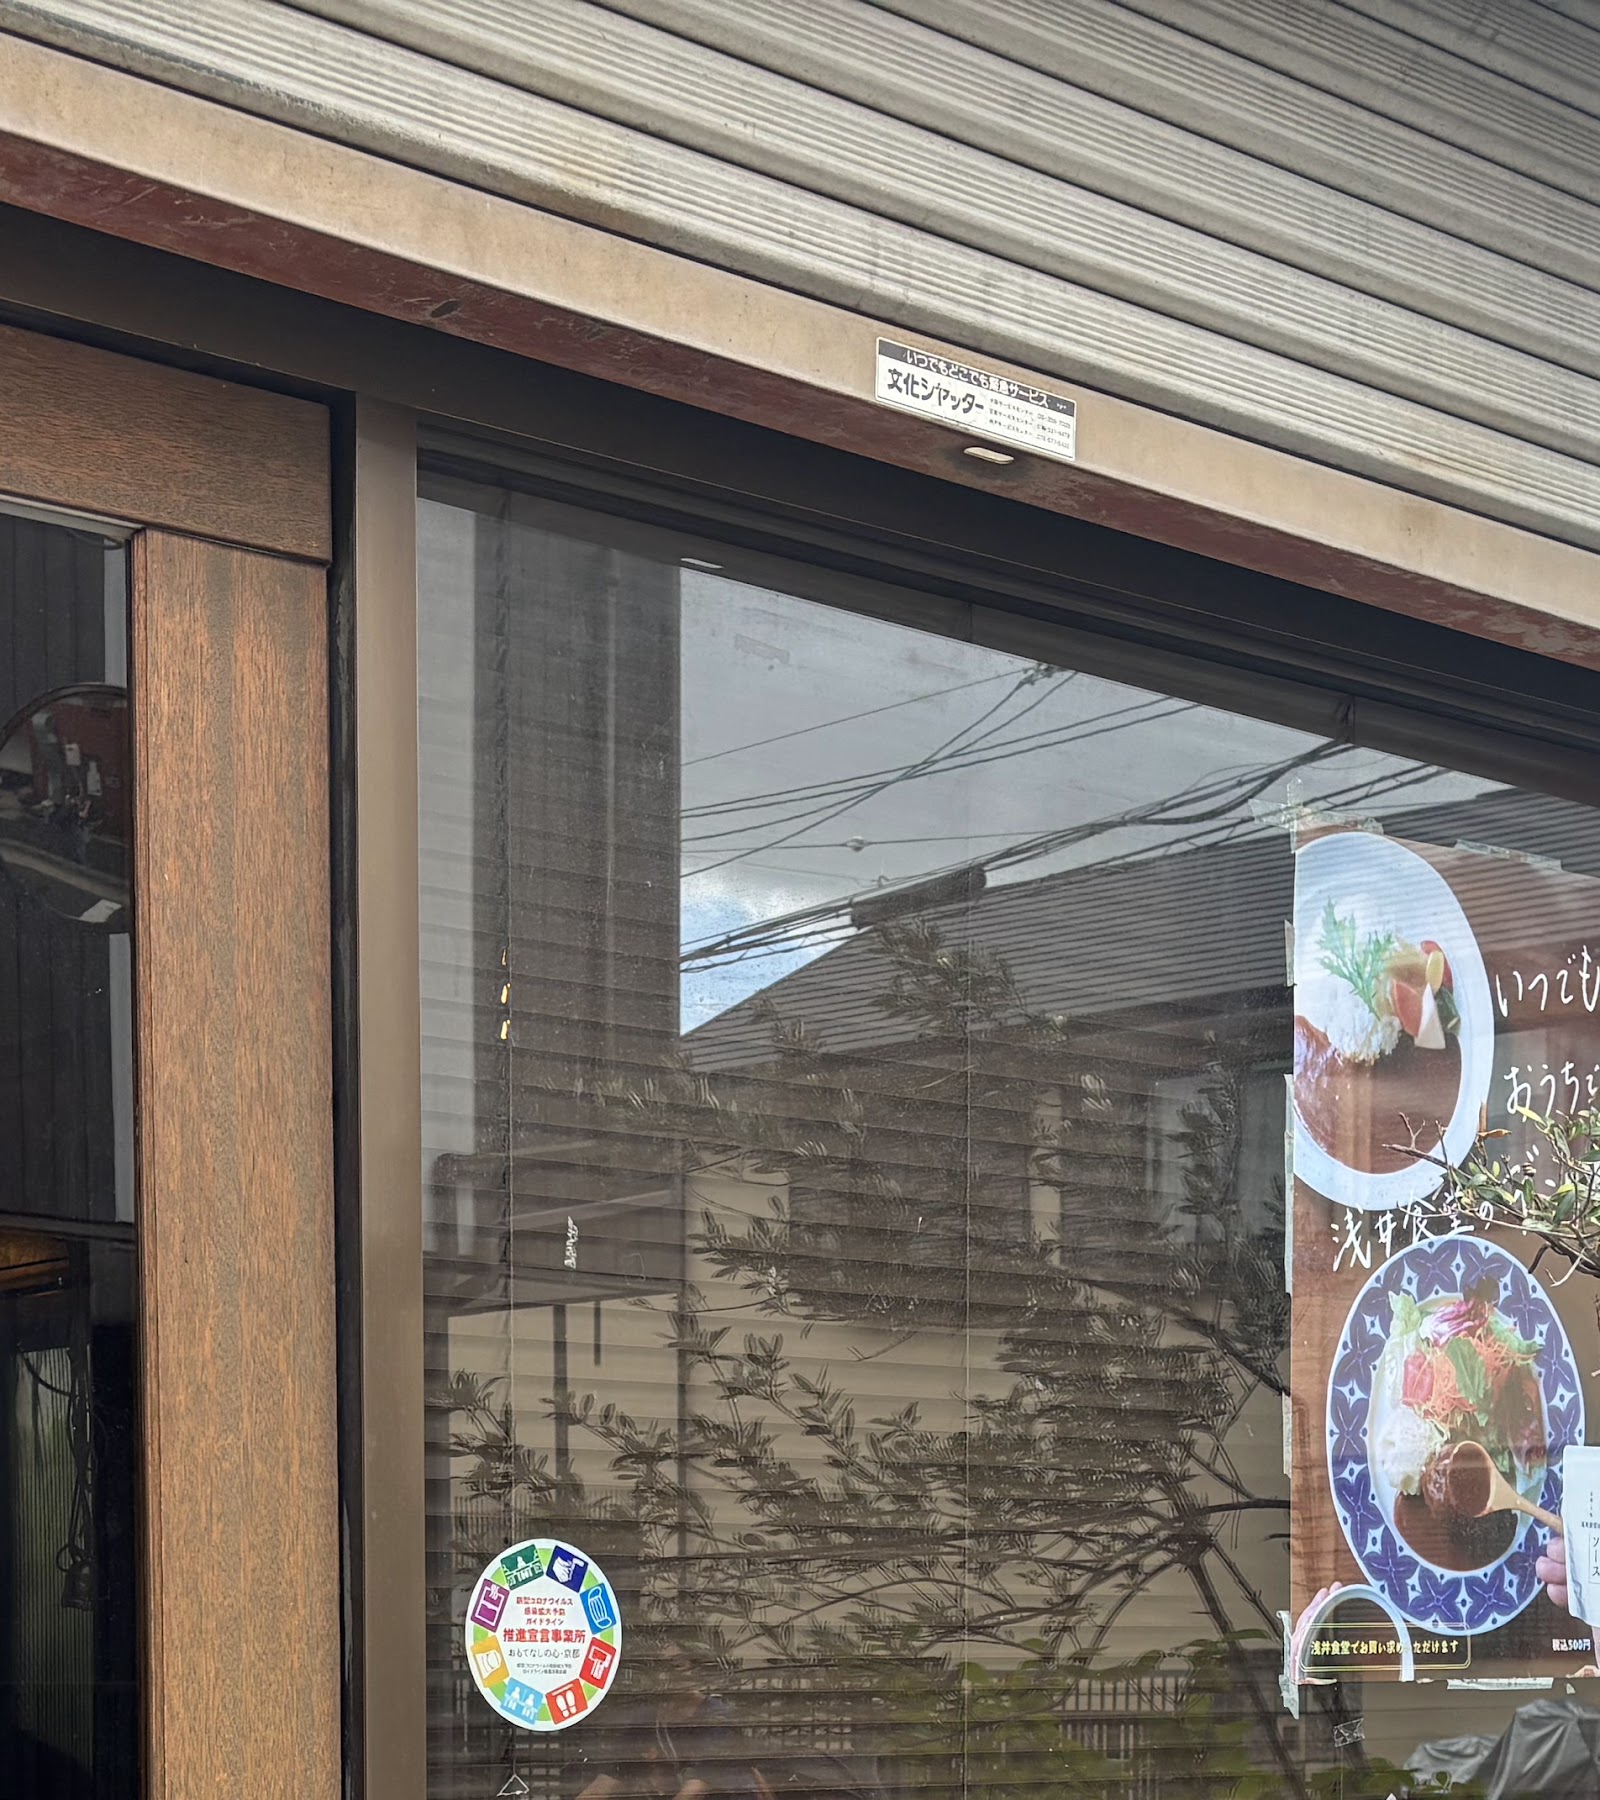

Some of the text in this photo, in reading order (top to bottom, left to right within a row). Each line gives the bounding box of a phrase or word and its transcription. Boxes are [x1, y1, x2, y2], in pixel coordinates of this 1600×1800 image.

[887, 367, 984, 413] 文化シャッター
[1496, 945, 1600, 1018] いつでも
[503, 1628, 586, 1644] 推進宣言事業所
[526, 1617, 564, 1626] ガイドライン
